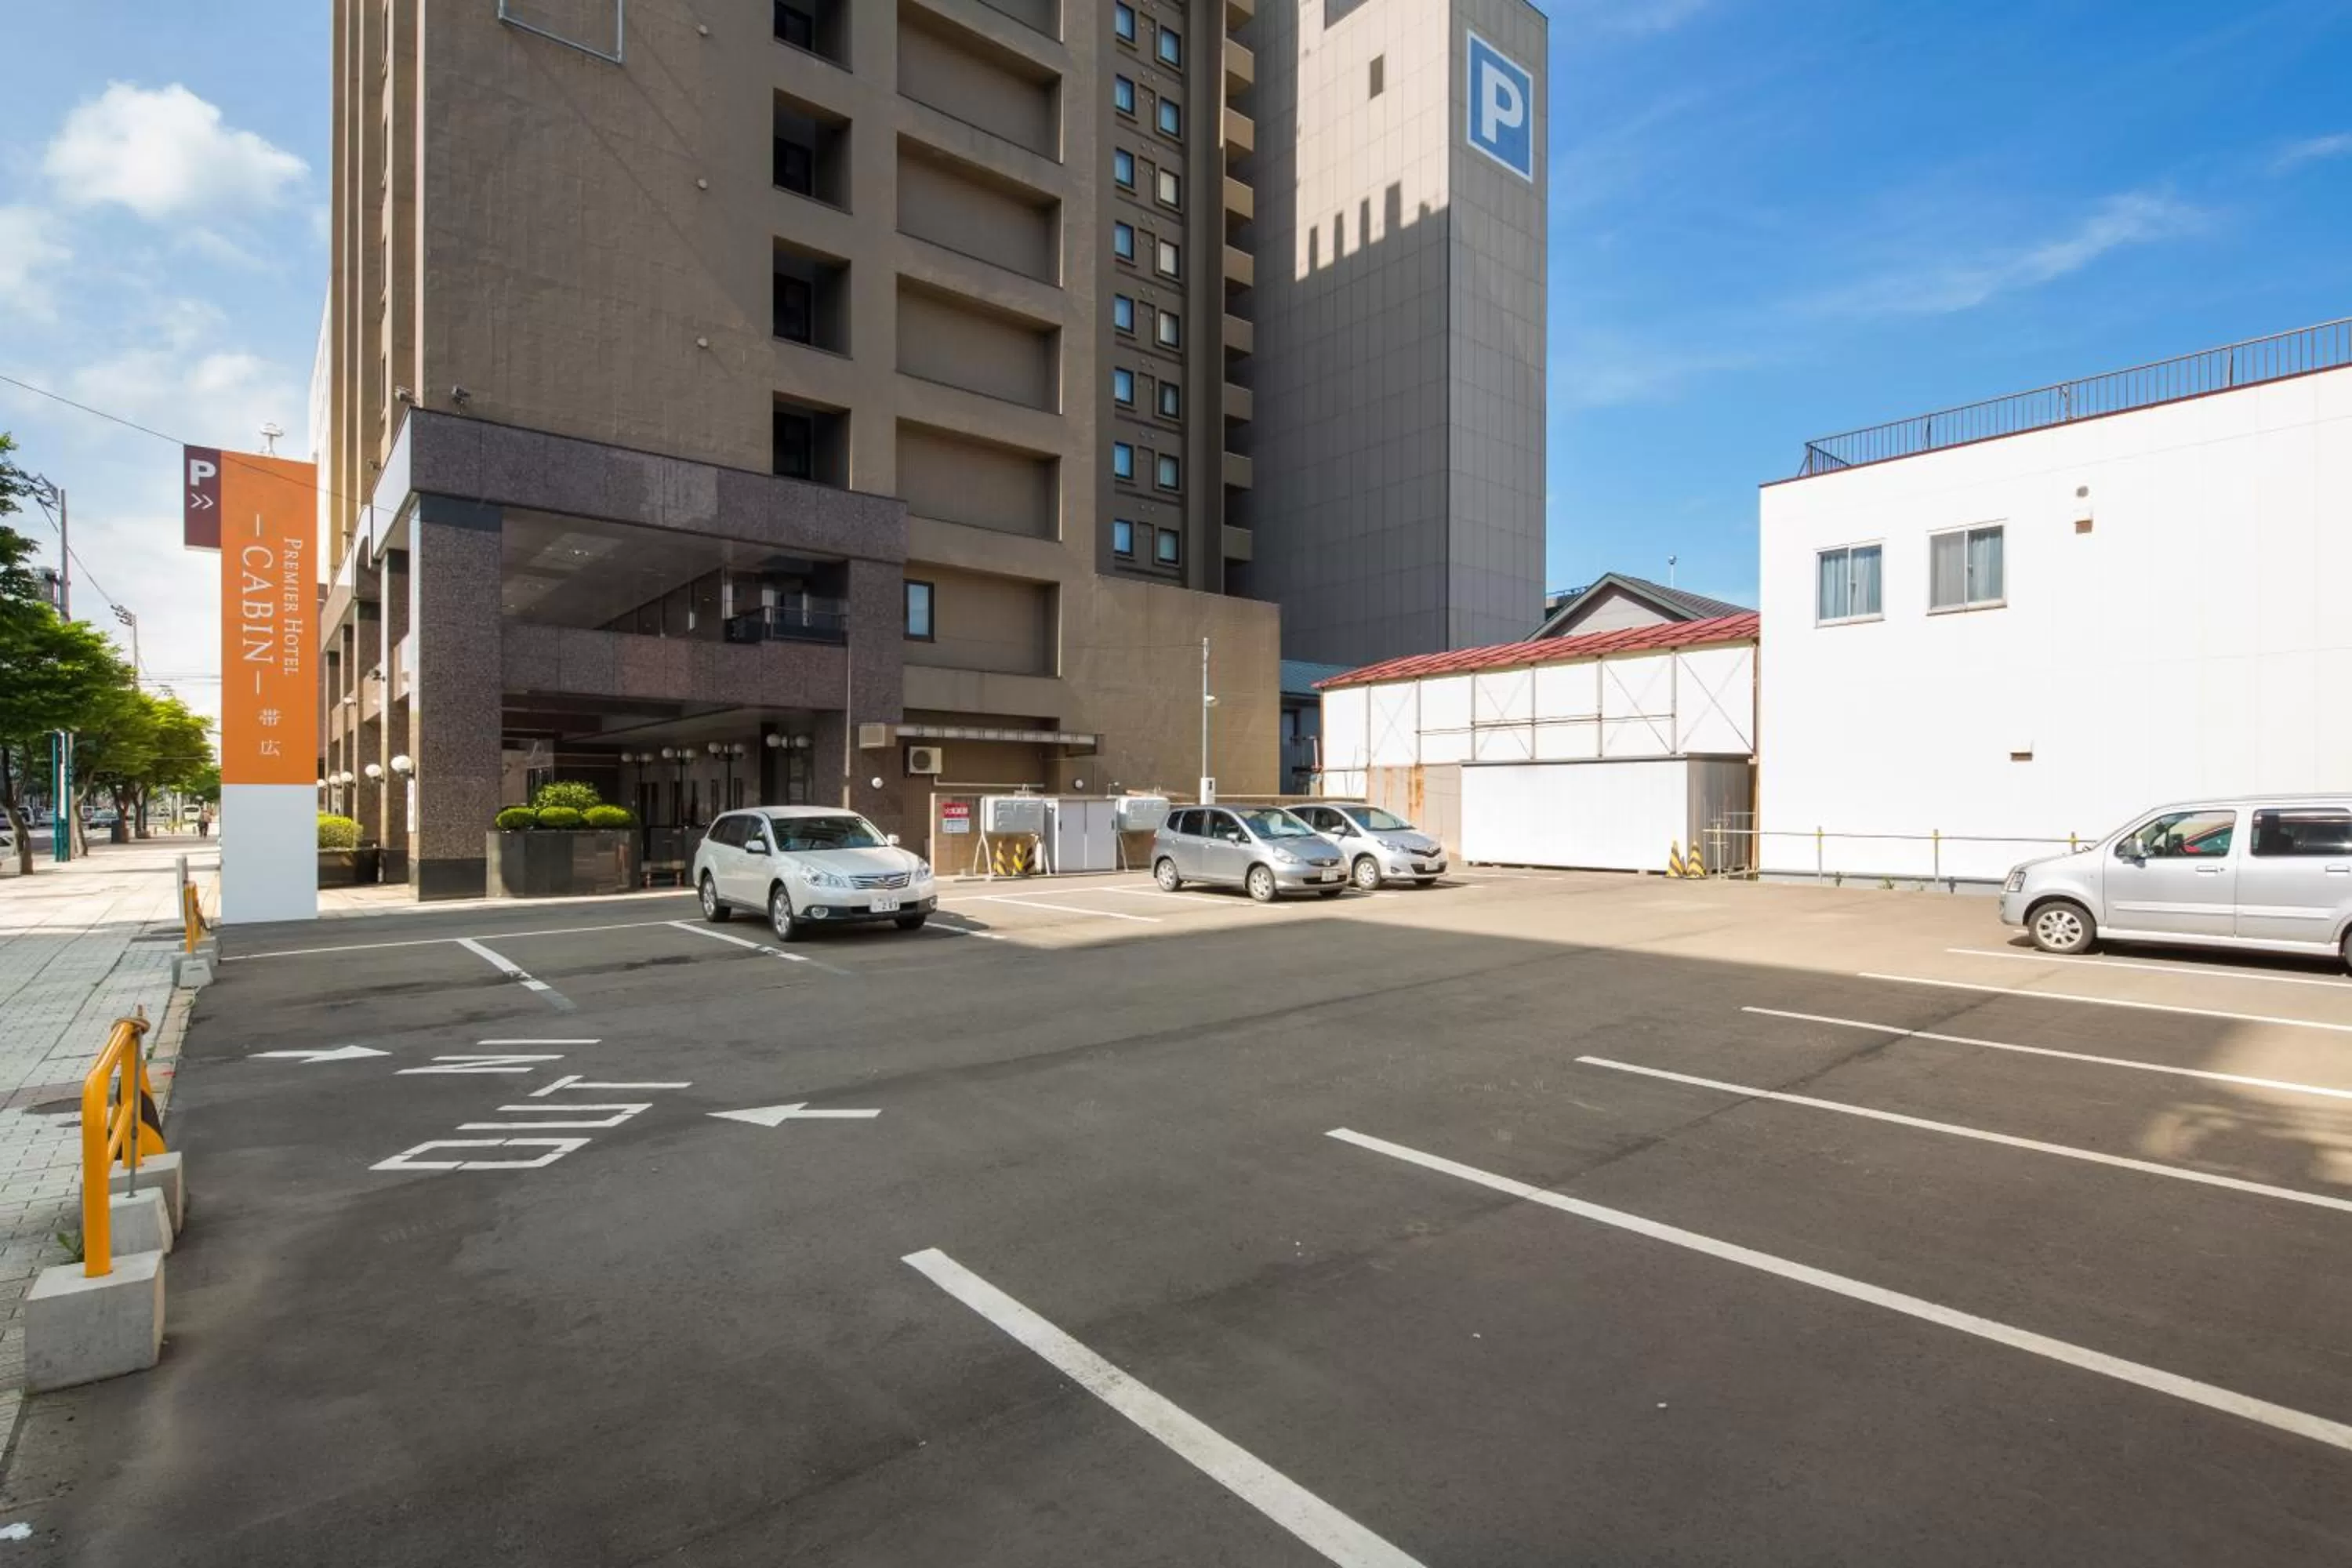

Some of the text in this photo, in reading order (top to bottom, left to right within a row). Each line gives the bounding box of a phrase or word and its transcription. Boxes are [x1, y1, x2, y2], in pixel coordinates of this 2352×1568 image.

[1482, 59, 1523, 145] P
[190, 459, 216, 486] P
[241, 546, 274, 664] CABIN
[283, 537, 303, 675] PREMIER HOTEL
[392, 1039, 603, 1075] IN
[368, 1075, 693, 1171] OUT
